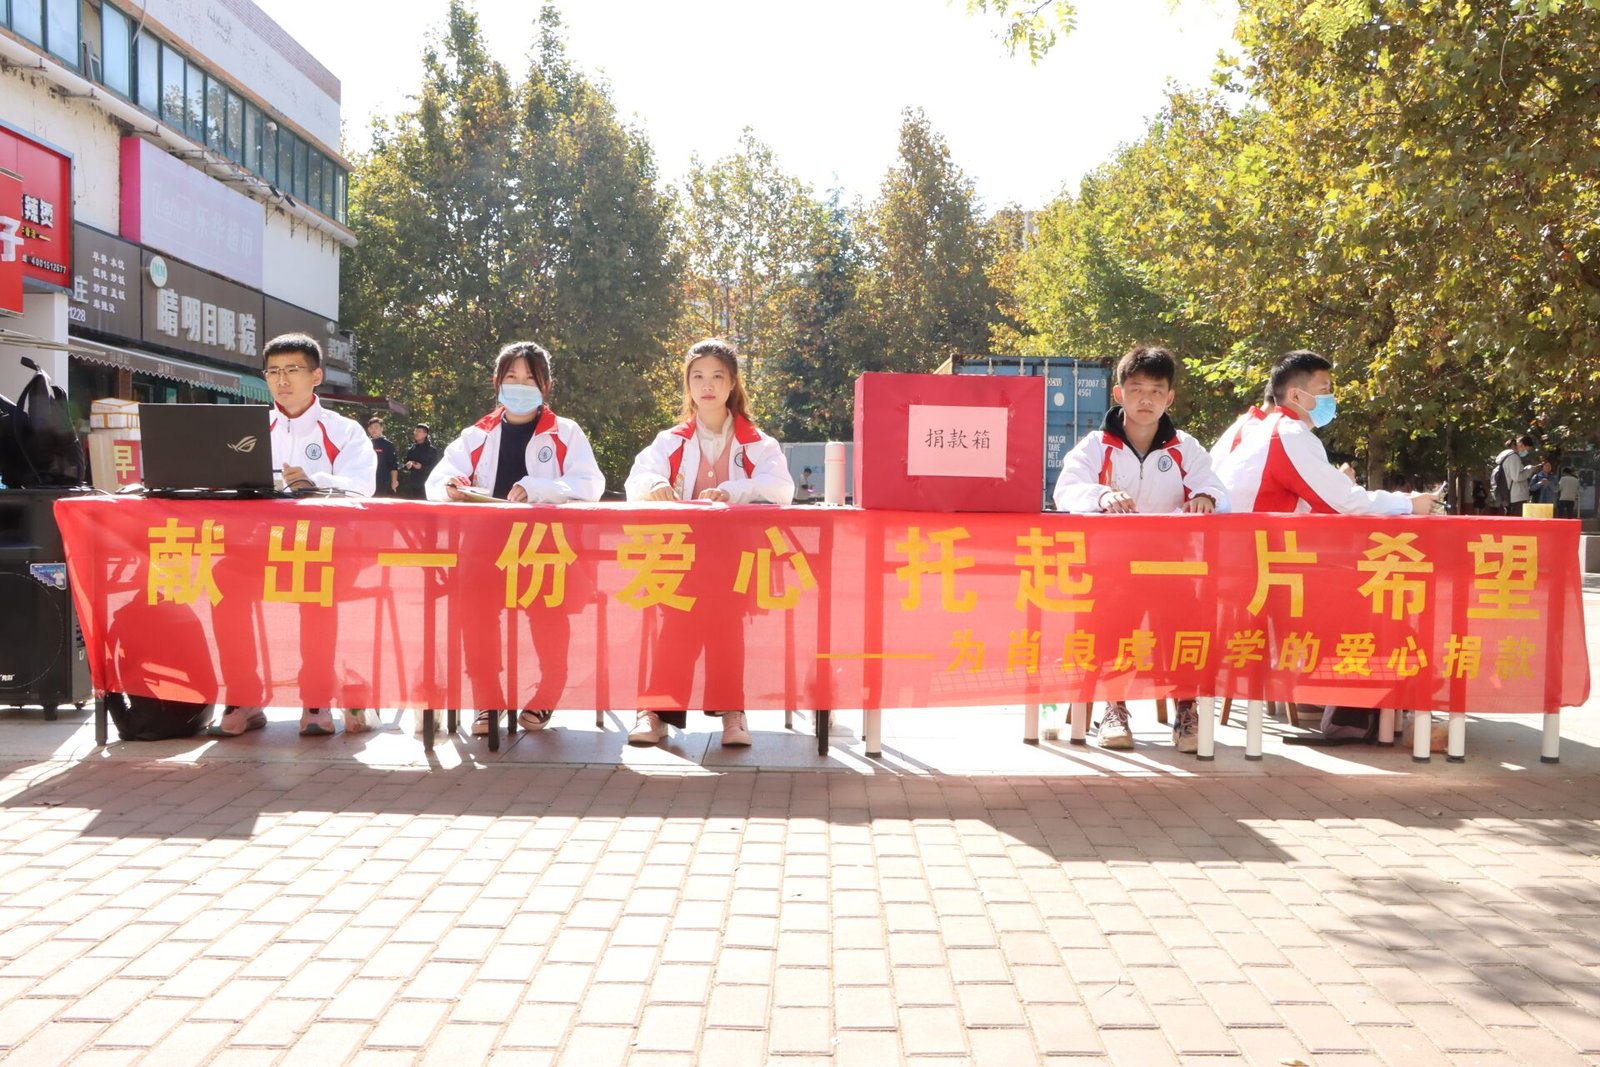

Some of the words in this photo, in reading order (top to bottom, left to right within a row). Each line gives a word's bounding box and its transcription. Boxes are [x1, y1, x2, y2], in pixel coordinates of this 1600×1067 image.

[22, 194, 54, 229] 辣烫
[924, 428, 990, 449] 捐款箱
